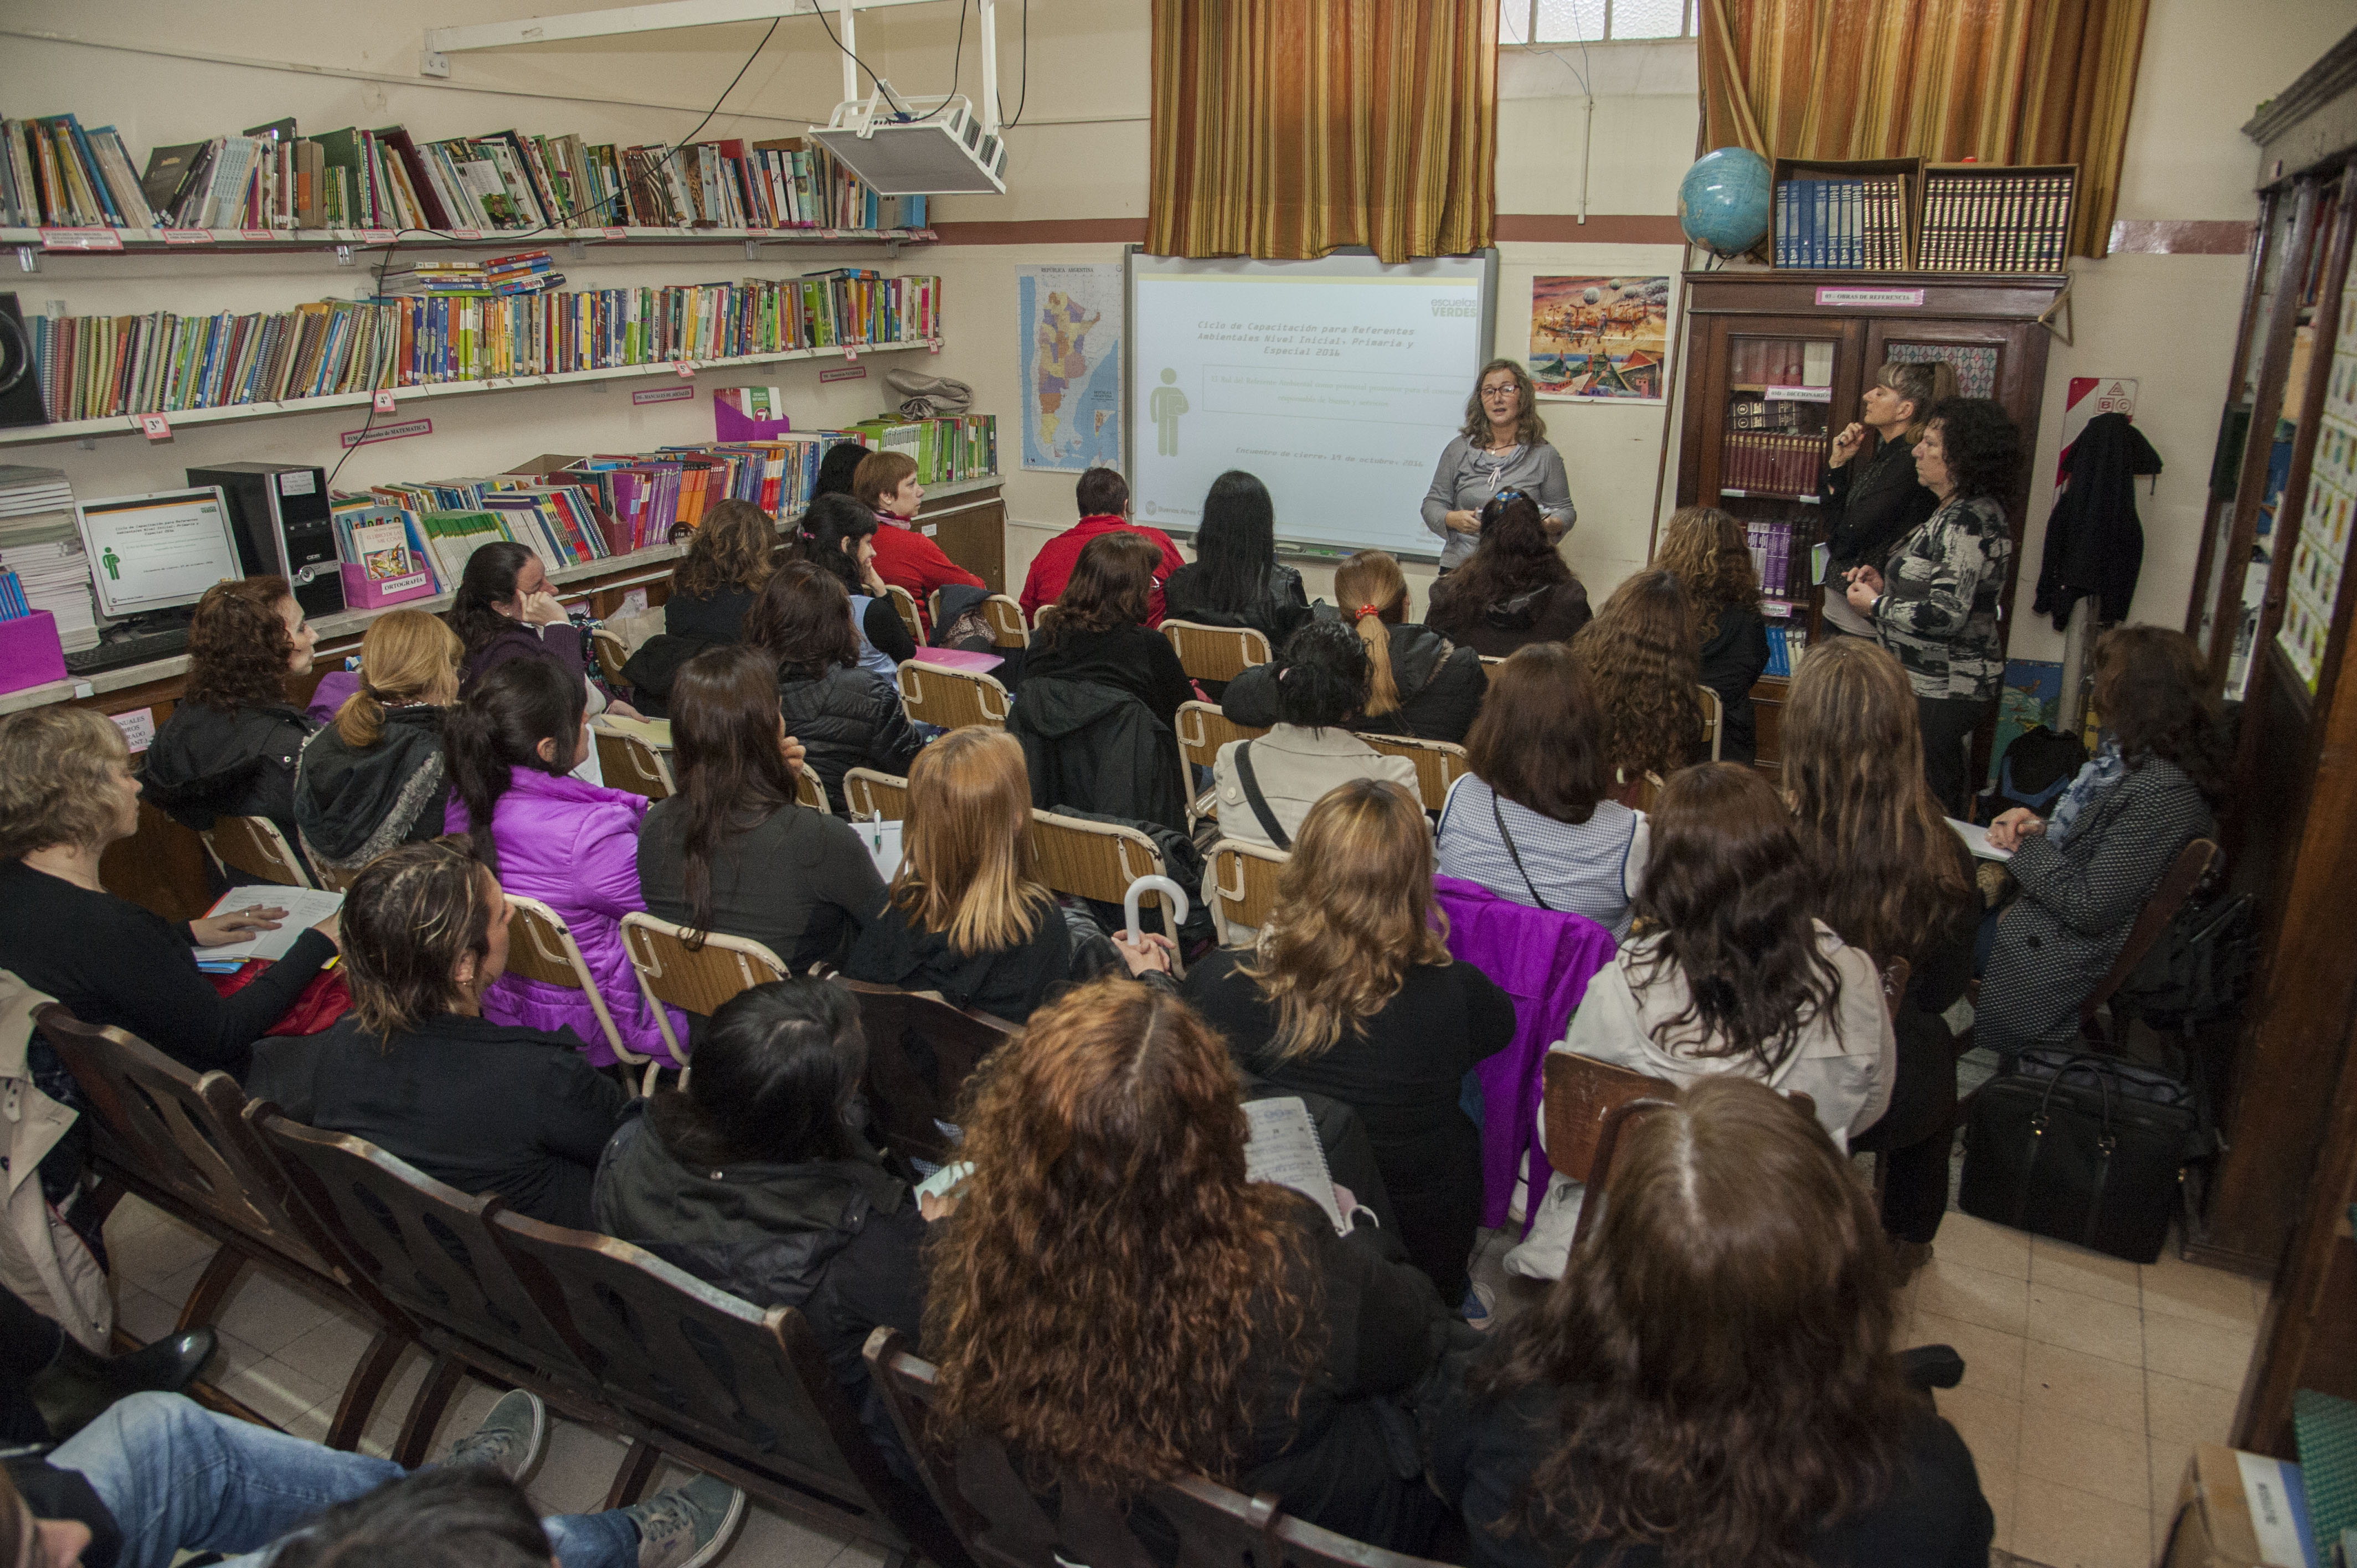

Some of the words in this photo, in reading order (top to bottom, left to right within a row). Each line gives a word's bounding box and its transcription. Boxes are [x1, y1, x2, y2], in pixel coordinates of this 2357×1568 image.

[1431, 307, 1476, 317] VERDES
[1248, 322, 1317, 332] Capacitación
[1321, 326, 1347, 334] para
[1352, 326, 1414, 336] Referentes
[1197, 333, 1260, 342] Ambientales
[1352, 338, 1402, 348] Primaria
[1264, 346, 1310, 355] Especial
[1316, 348, 1341, 357] 2016
[757, 411, 766, 421] 7
[149, 420, 159, 430] 3º
[389, 425, 426, 435] MATEMATICA
[1236, 447, 1277, 456] Encuentro
[1157, 506, 1179, 514] Buenos
[385, 576, 423, 590] ORTOGRAFÍA
